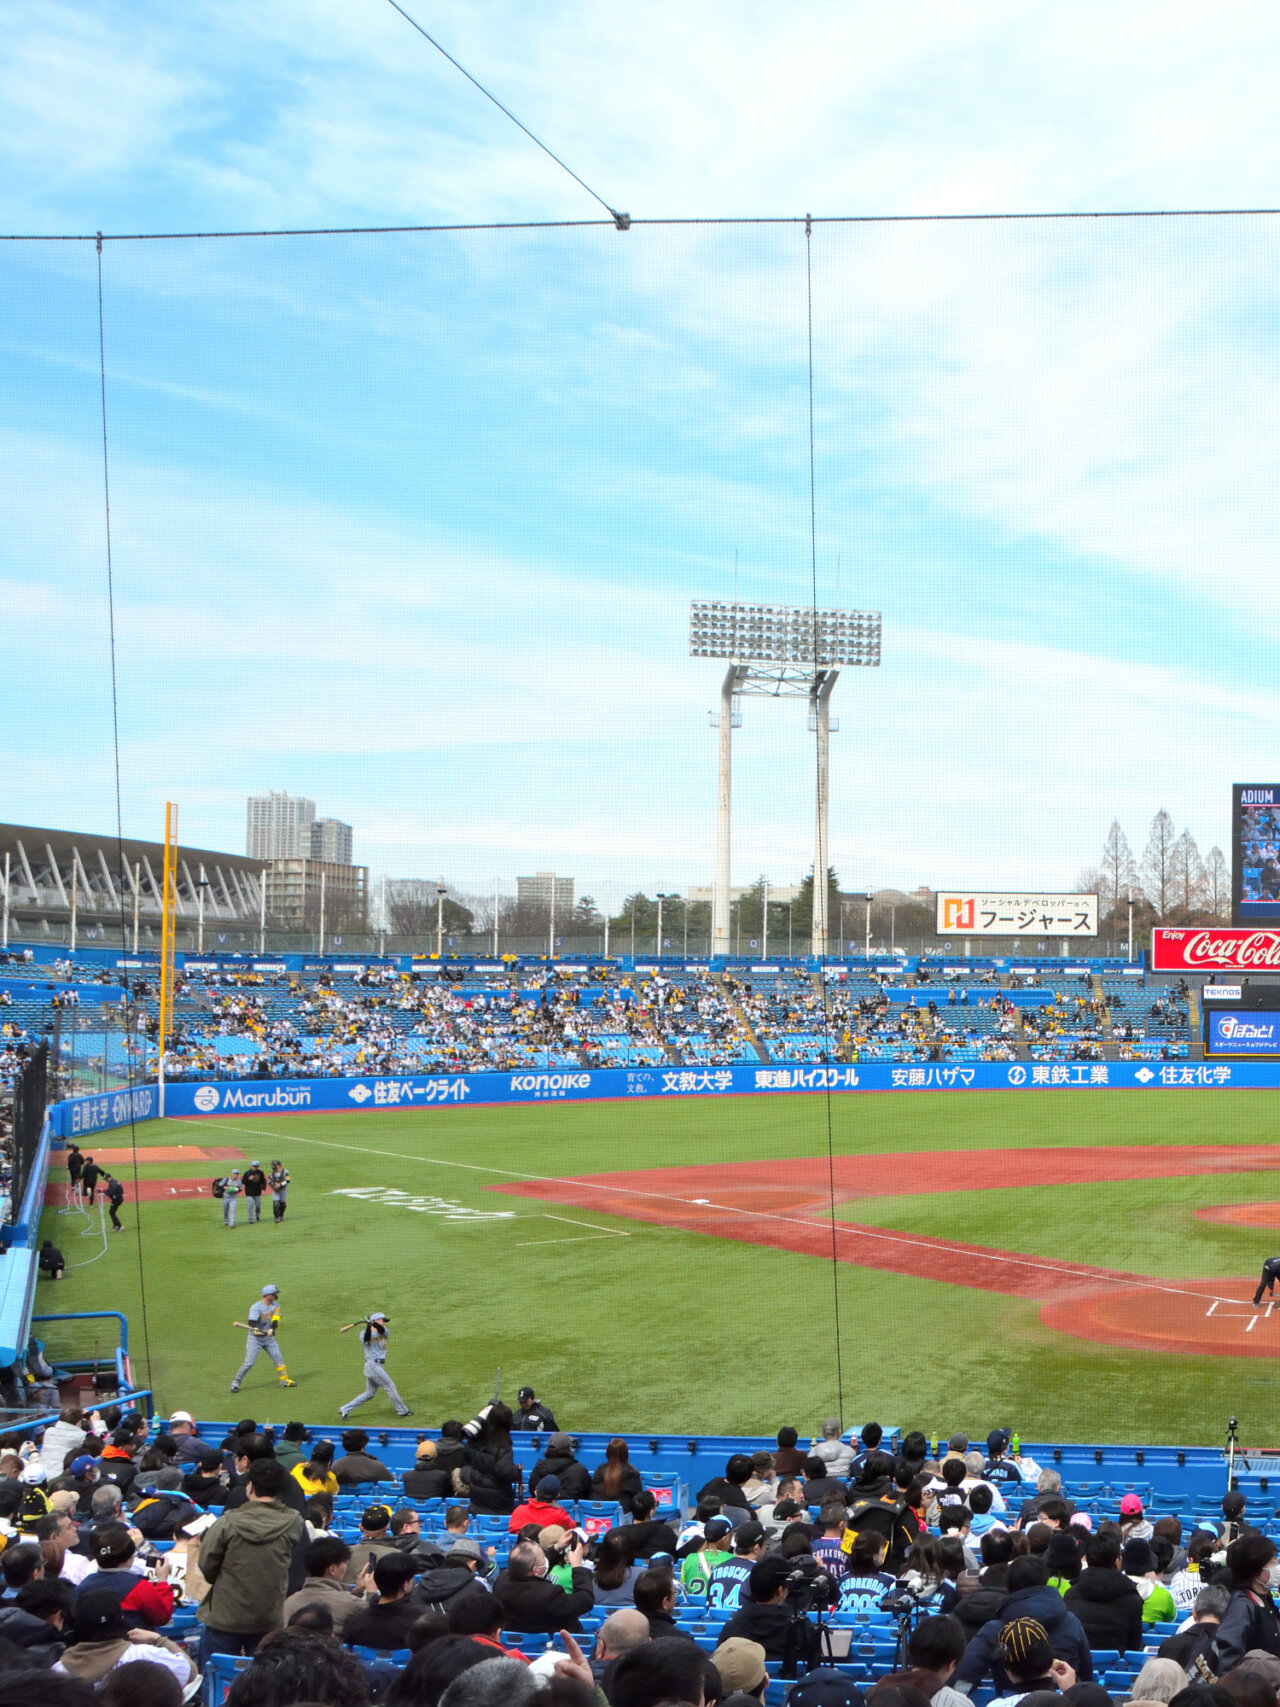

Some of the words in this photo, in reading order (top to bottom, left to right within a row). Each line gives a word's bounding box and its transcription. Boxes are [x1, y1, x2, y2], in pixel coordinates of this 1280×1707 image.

[980, 909, 1090, 930] フージャース
[1162, 930, 1184, 940] Enjoy
[627, 1072, 654, 1082] 育ての、
[662, 1070, 732, 1092] 文教大学
[755, 1068, 859, 1088] 東進ハイスクール
[892, 1068, 975, 1086] 安藤ハザマ
[1032, 1066, 1109, 1084] 東鉄工業
[1160, 1066, 1231, 1084] 住友化学
[223, 1087, 310, 1108] Marubun
[374, 1078, 470, 1104] 住友ベークライト
[712, 1568, 750, 1582] TAGUCHI
[710, 1582, 742, 1609] 34
